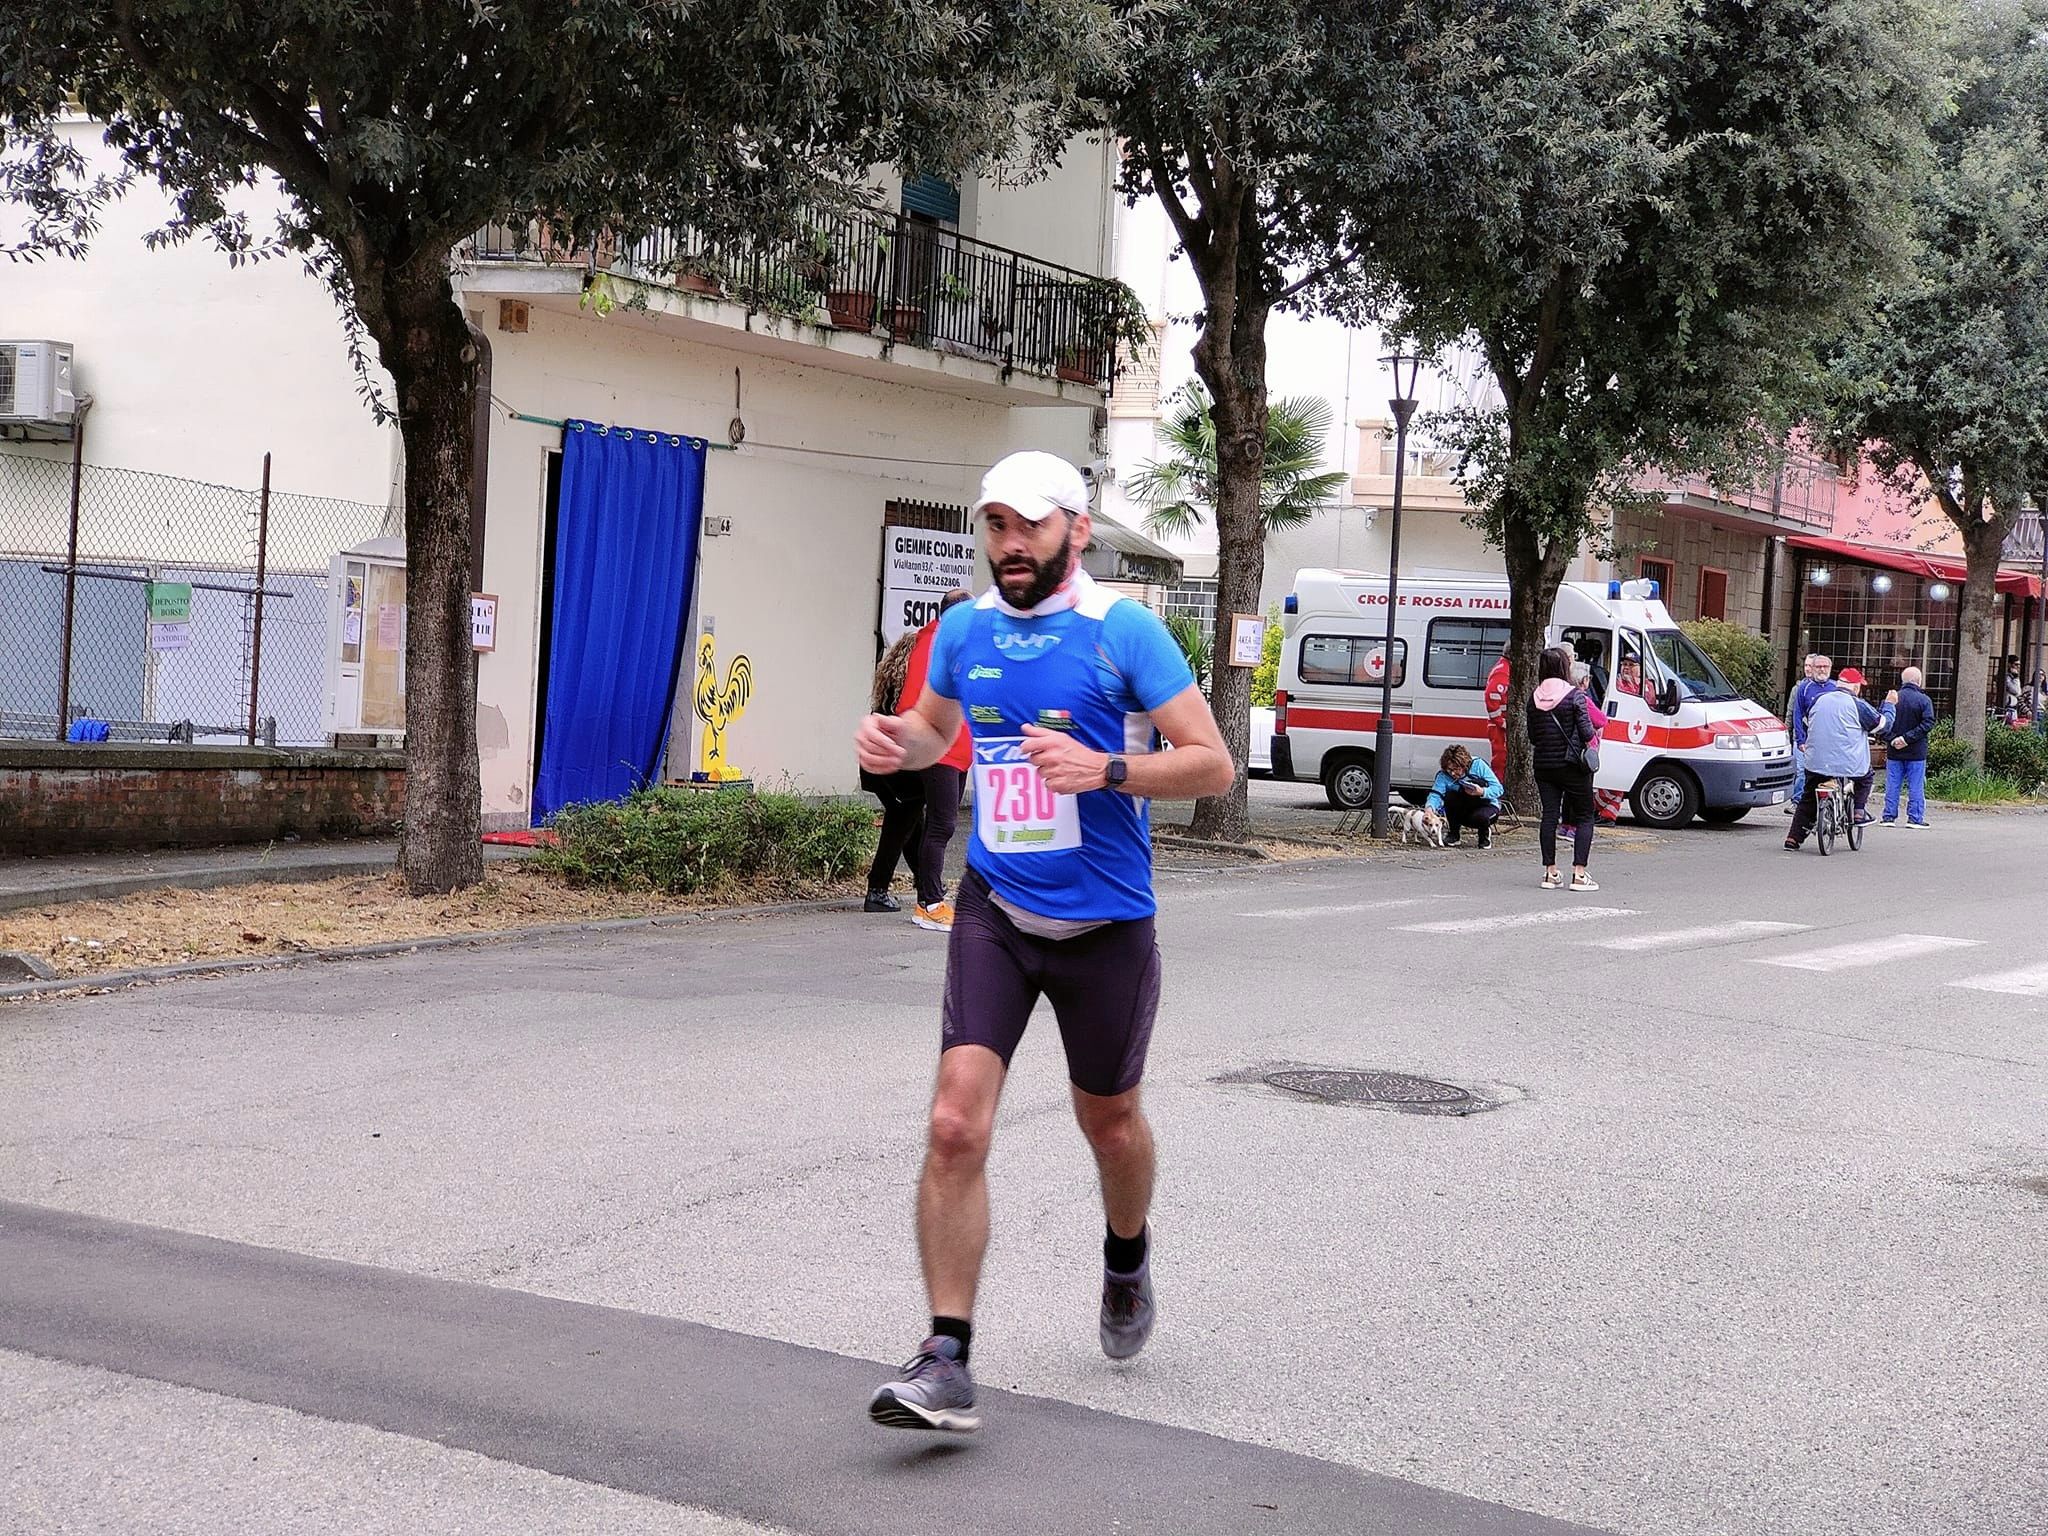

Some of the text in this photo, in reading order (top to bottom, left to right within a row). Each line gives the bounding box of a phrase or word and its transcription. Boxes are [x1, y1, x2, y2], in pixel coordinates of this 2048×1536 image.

[720, 519, 730, 532] 68
[1412, 596, 1463, 608] ROSSA
[161, 608, 183, 616] BORSE
[988, 767, 1054, 822] 230
